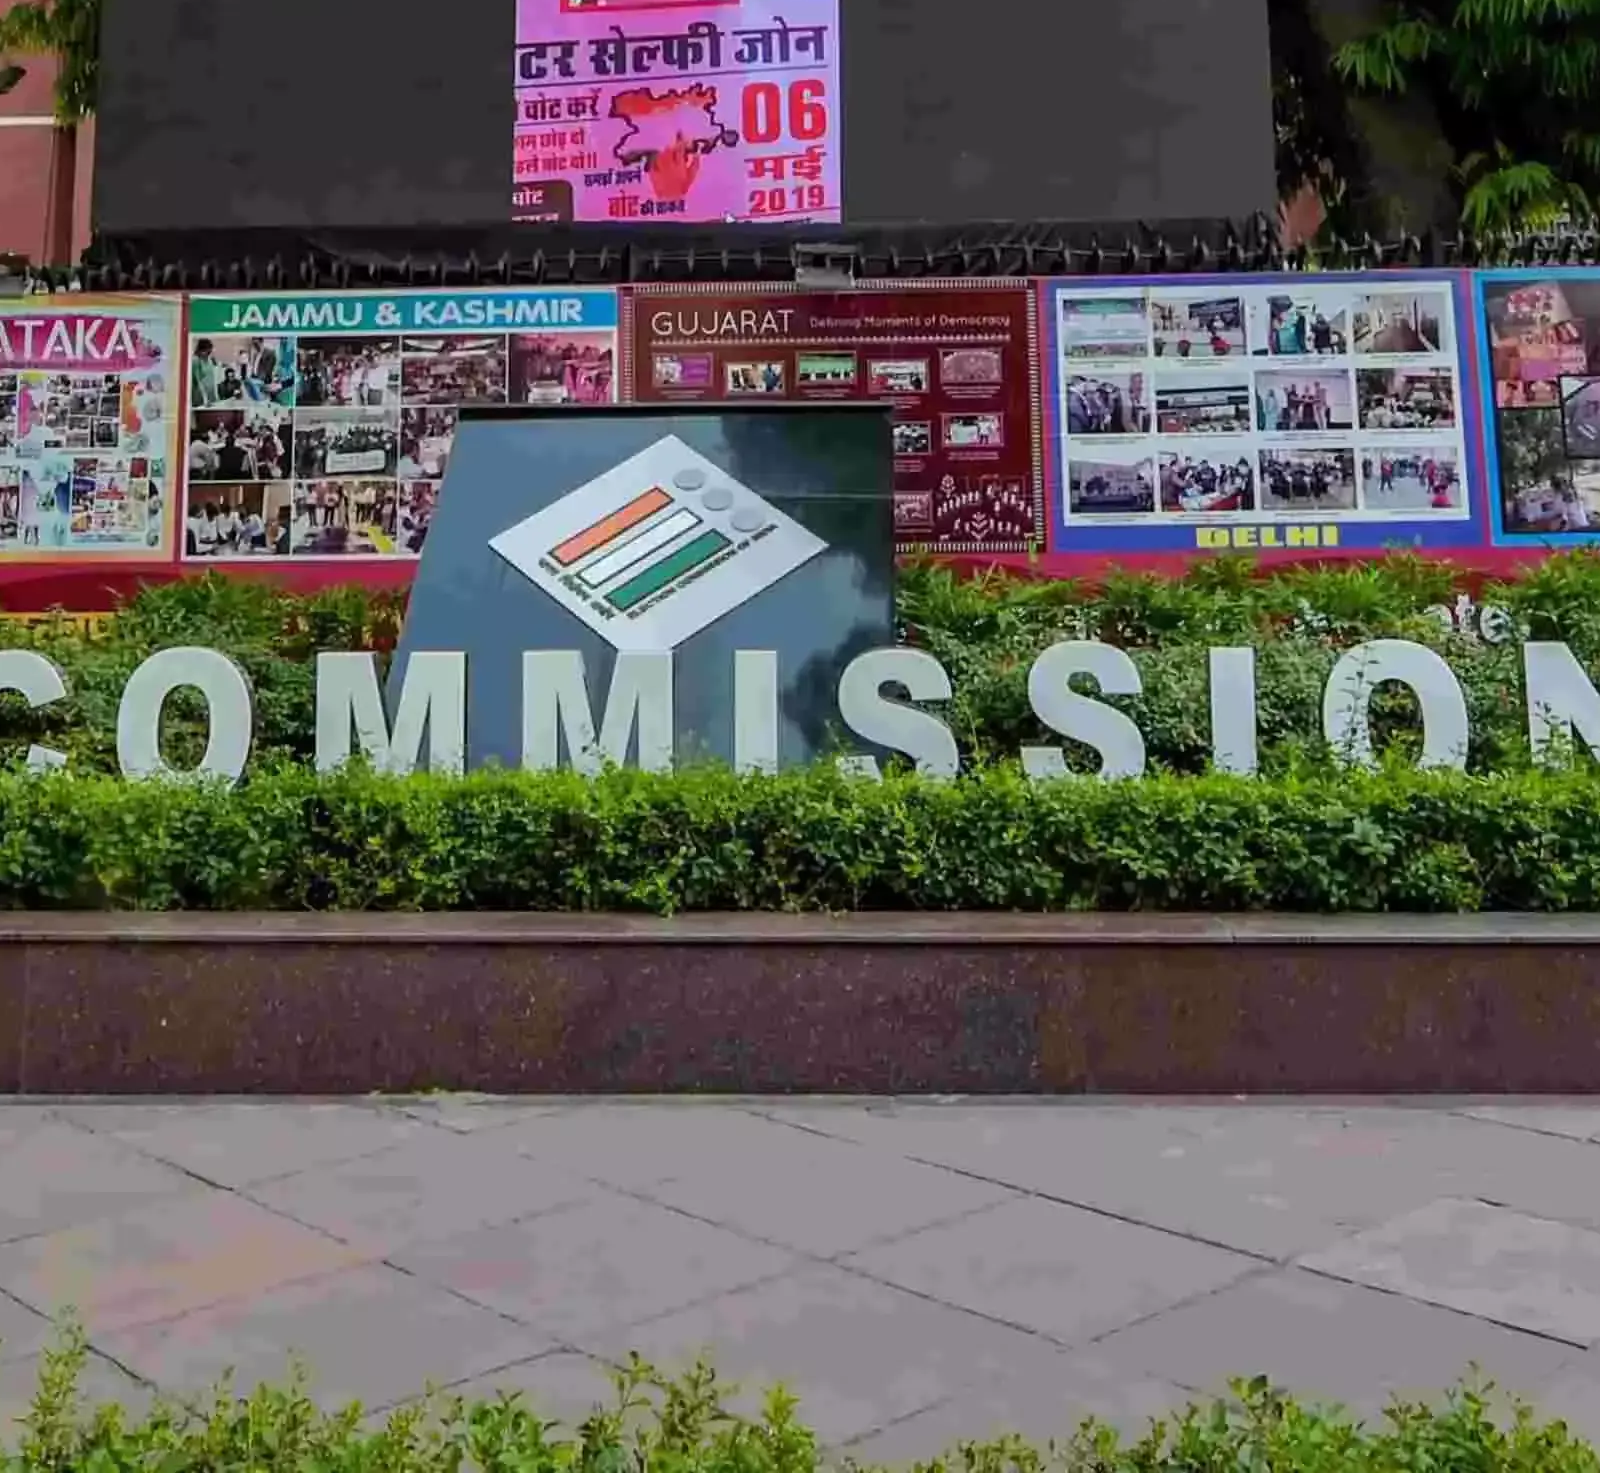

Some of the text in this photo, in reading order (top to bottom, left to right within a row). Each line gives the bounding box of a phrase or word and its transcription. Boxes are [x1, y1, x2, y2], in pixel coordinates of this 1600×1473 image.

[589, 21, 725, 75] सेल्फी
[732, 16, 828, 64] जोन
[524, 87, 602, 120] वोट करें
[742, 79, 826, 144] 06
[744, 144, 826, 181] मई
[608, 190, 639, 217] वोट
[749, 184, 824, 213] 2019
[222, 298, 583, 329] JAMMU & KASHMIR
[651, 309, 795, 336] GUJARAT
[864, 314, 921, 327] Moments
[924, 313, 937, 327] of
[939, 314, 1010, 328] Democracy
[1196, 525, 1338, 549] DELHI
